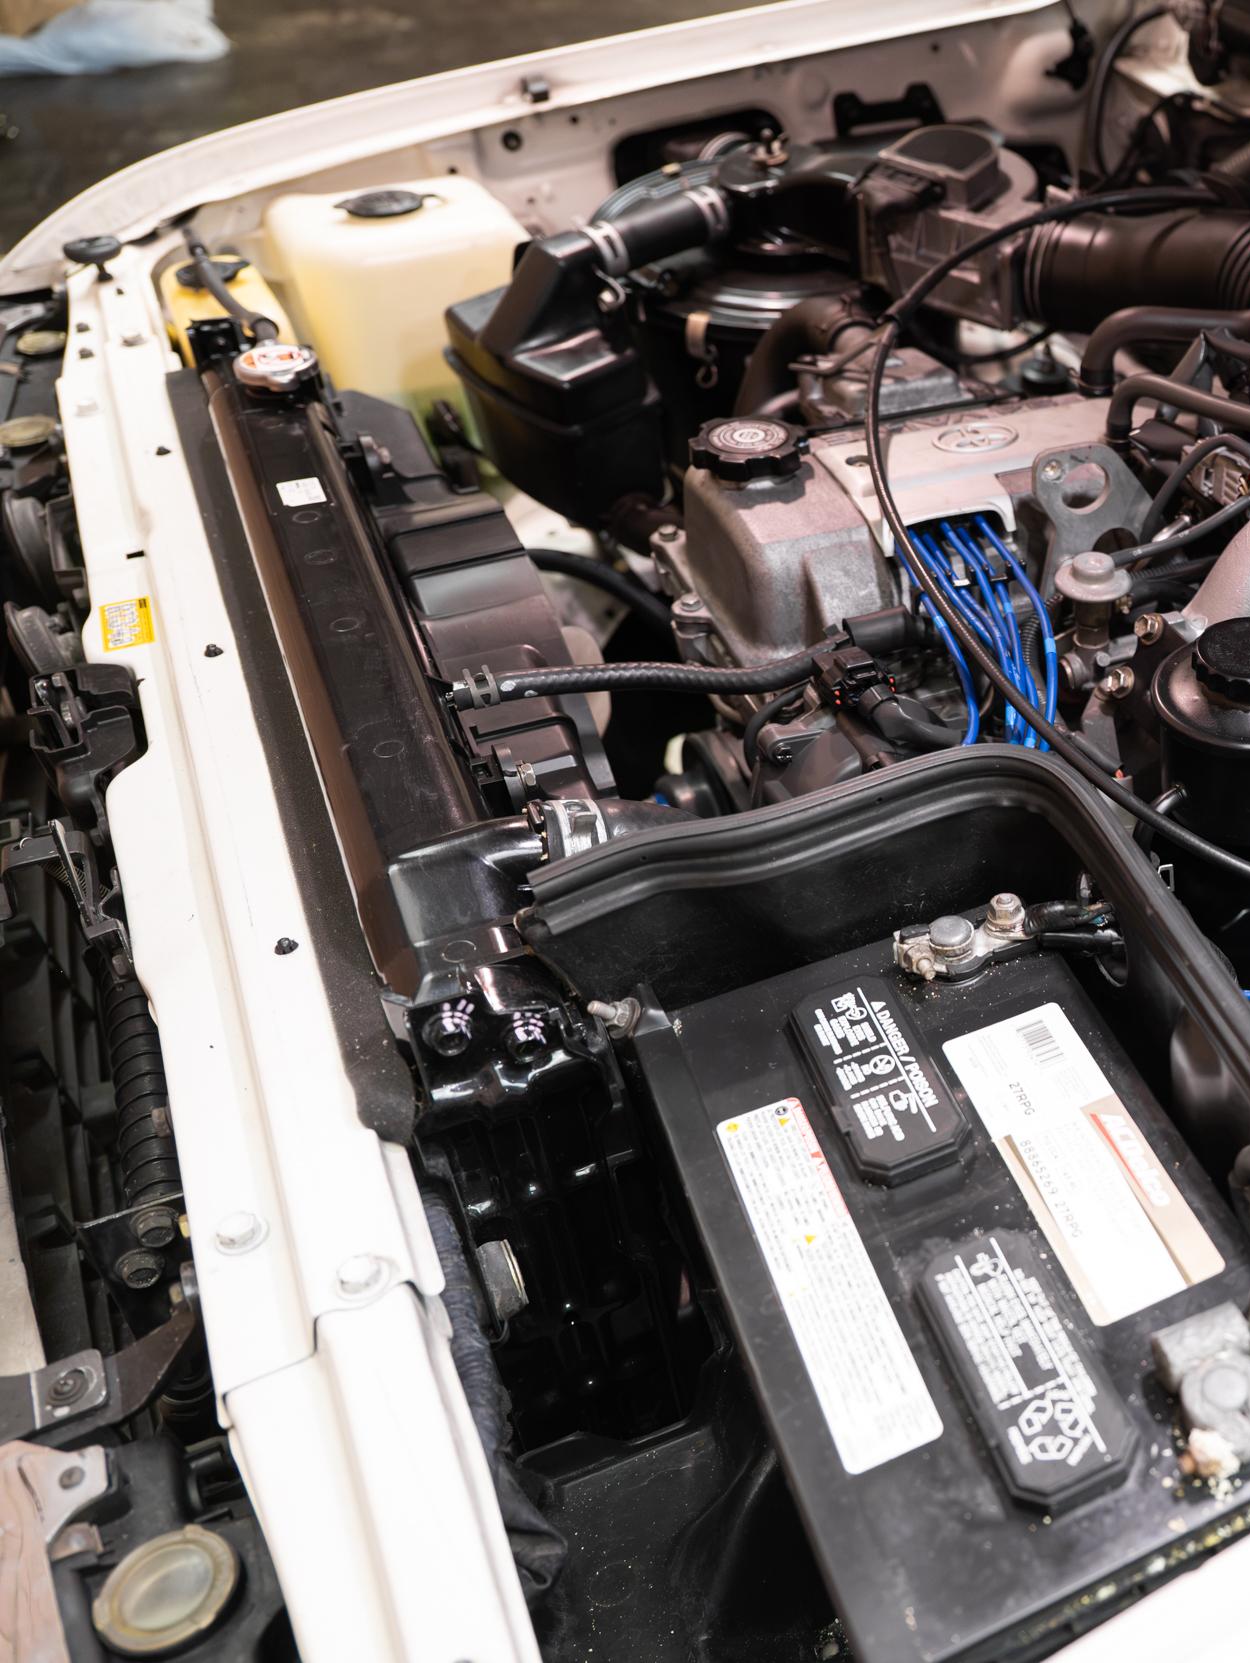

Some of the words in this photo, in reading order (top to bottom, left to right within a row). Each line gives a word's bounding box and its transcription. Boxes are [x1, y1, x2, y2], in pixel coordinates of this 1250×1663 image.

[877, 1009, 909, 1056] DANGER
[904, 1062, 938, 1108] POISON
[1008, 1081, 1036, 1117] 27RPG
